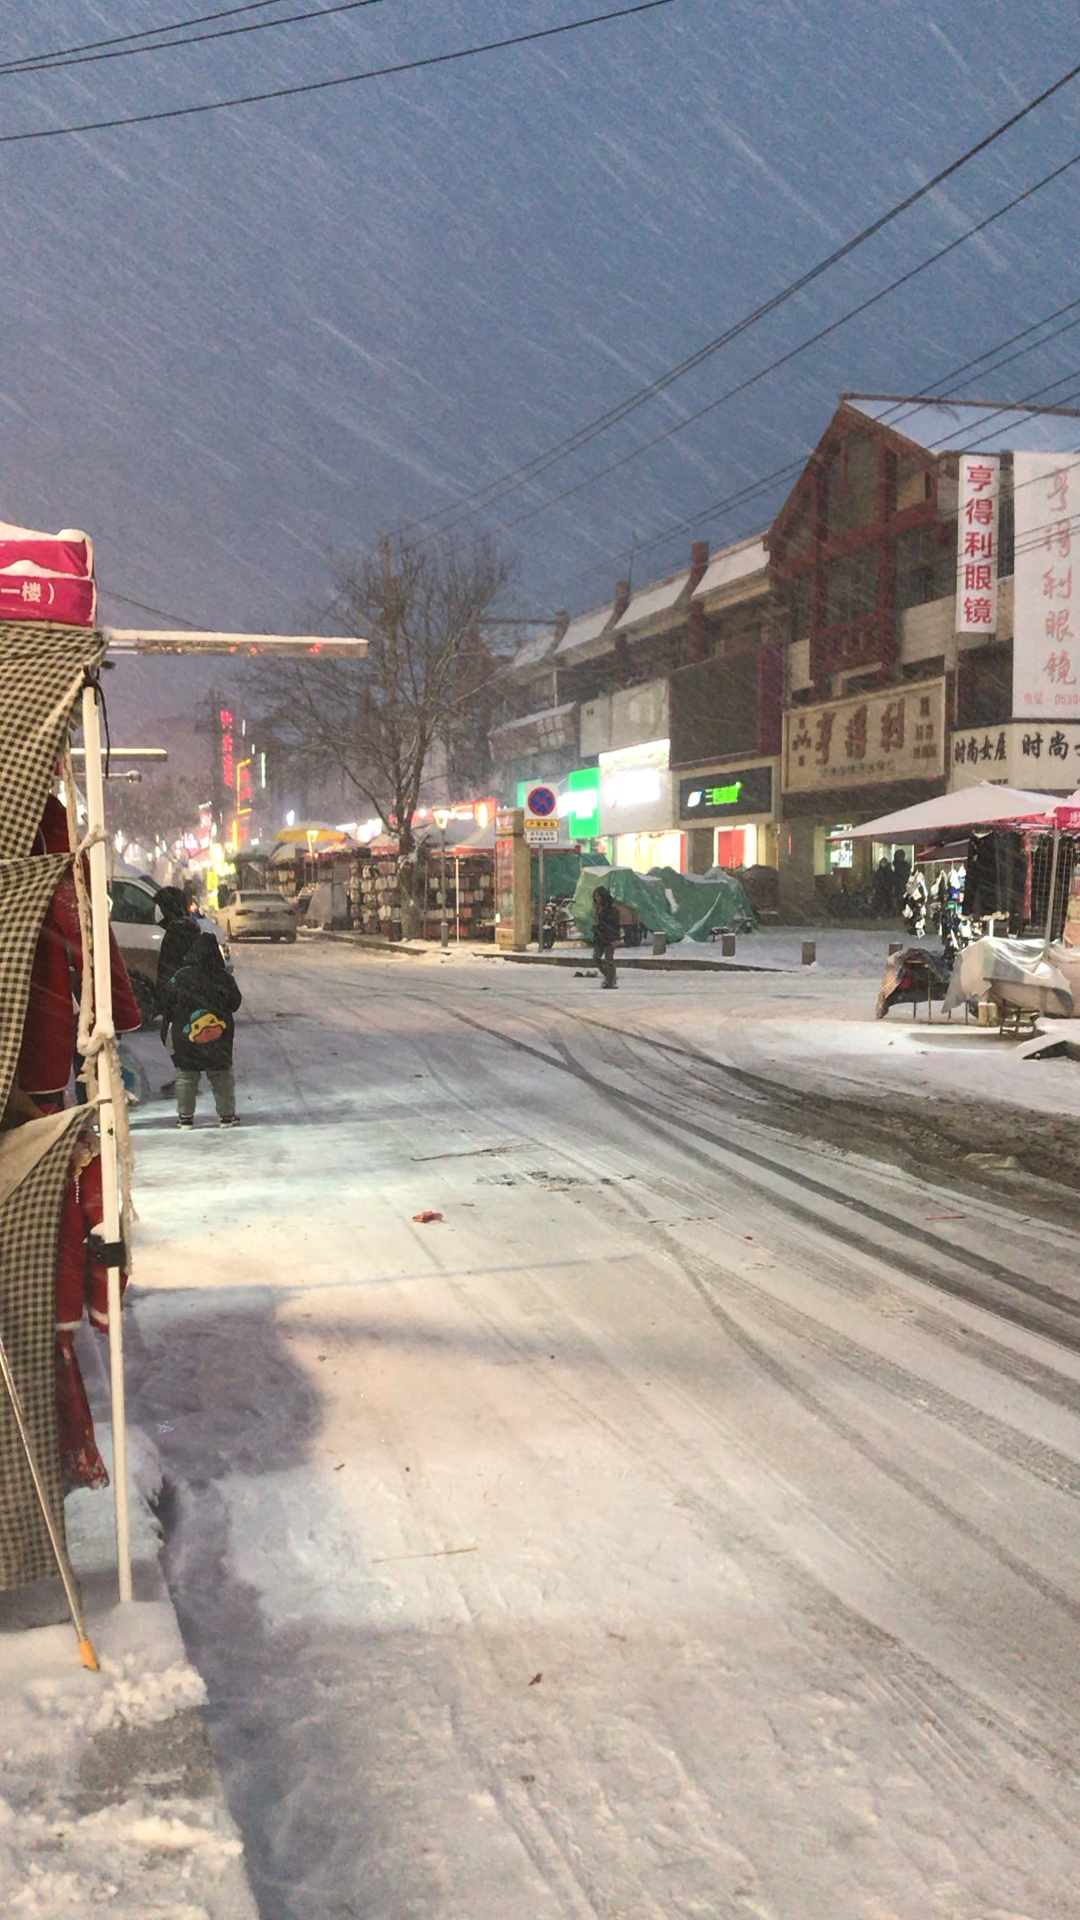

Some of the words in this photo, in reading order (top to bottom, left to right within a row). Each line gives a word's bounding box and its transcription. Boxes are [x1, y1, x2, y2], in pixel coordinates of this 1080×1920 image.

[964, 465, 995, 625] 亨得利眼镜
[1042, 465, 1077, 686] 亨得利眼镜
[954, 732, 1008, 765] 时尚女屋
